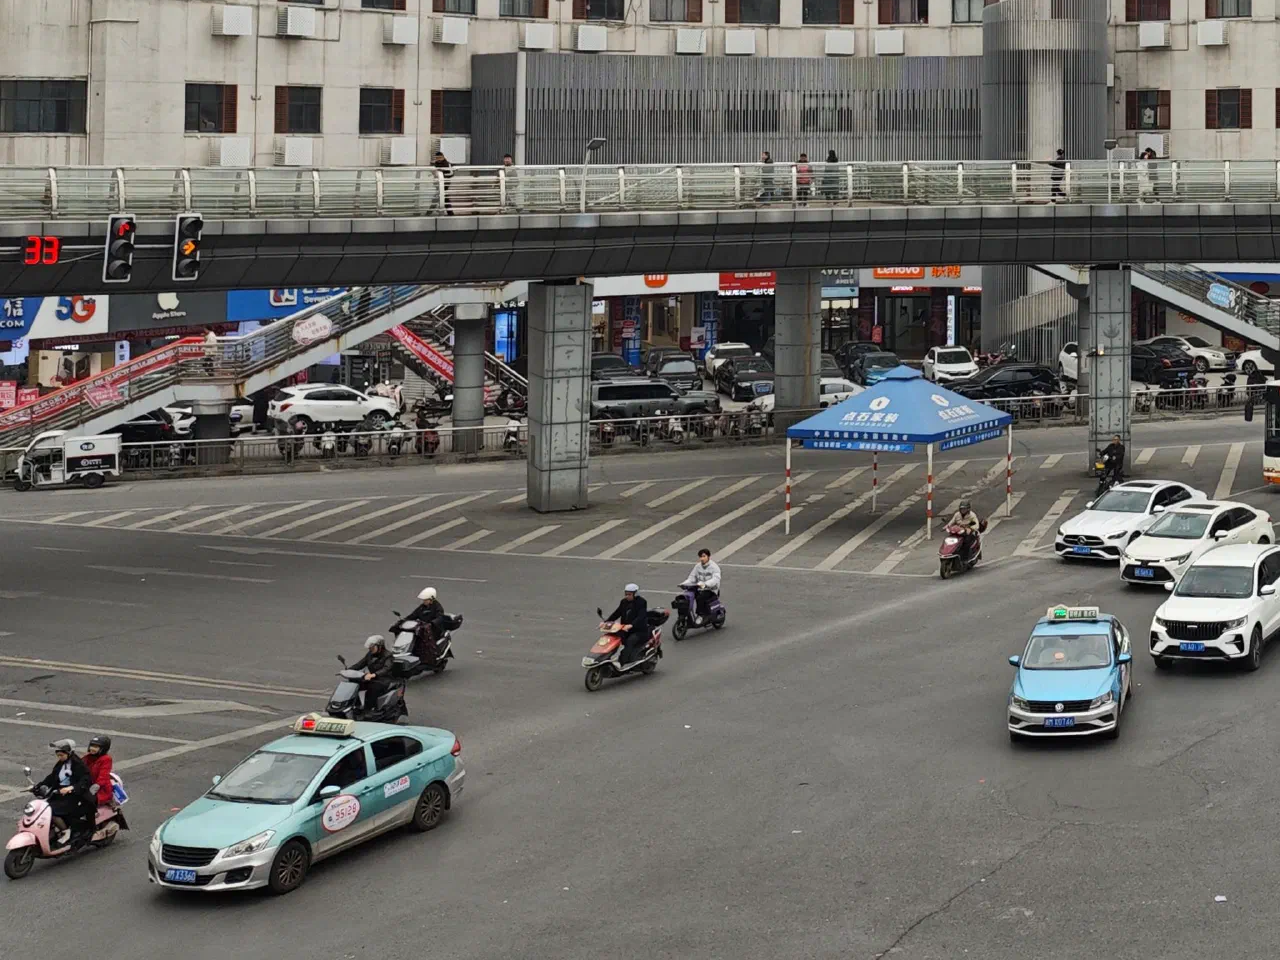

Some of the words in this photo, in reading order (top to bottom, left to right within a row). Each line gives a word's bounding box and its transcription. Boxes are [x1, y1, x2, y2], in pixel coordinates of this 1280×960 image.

[25, 236, 59, 264] 33
[55, 296, 96, 323] 5G
[152, 311, 169, 320] Apple
[335, 803, 357, 821] 95128
